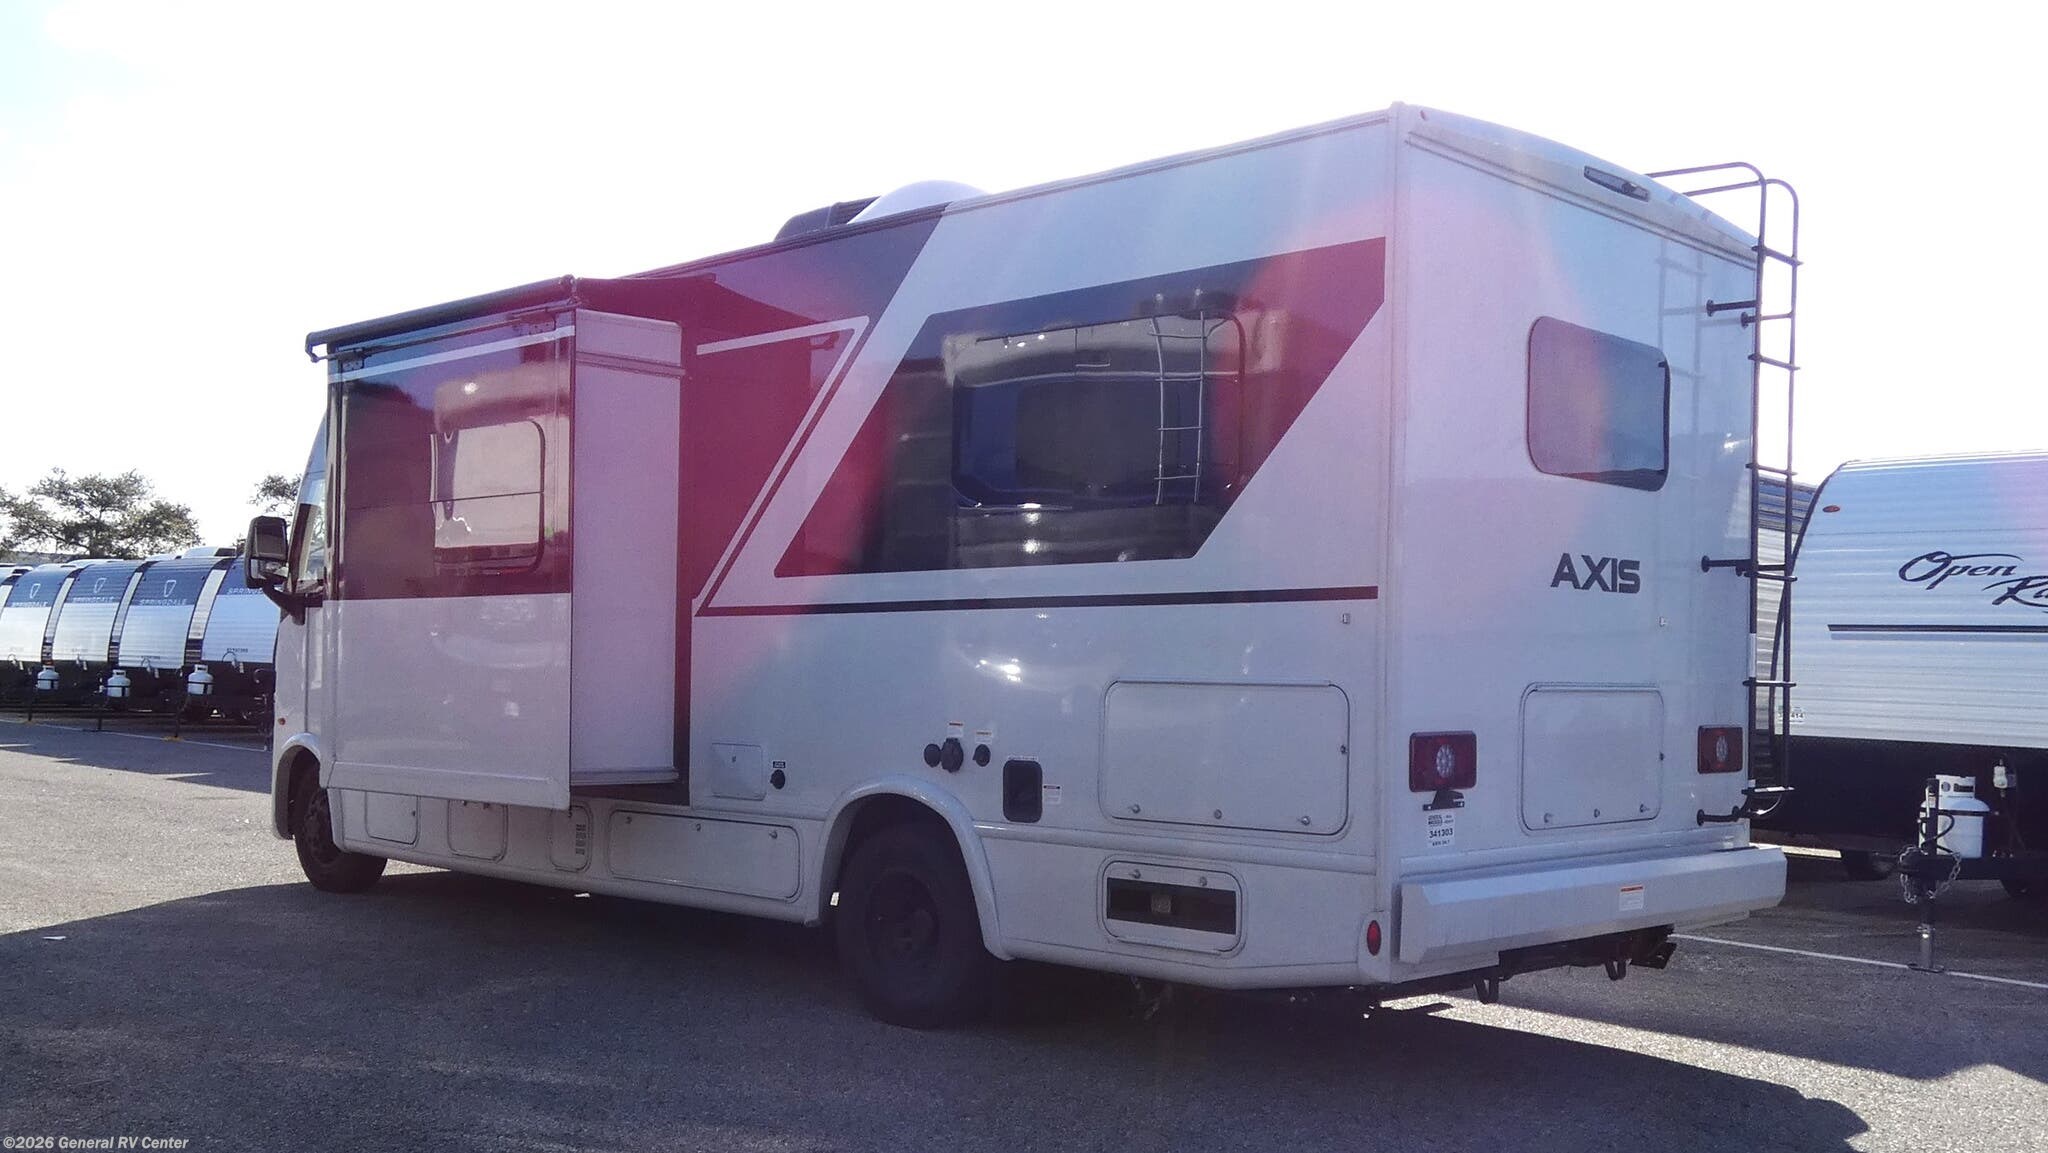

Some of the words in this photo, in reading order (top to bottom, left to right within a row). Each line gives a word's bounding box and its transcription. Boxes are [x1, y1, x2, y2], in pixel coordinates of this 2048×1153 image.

[1551, 552, 1641, 594] AXIS
[1899, 551, 2024, 590] Open
[139, 598, 188, 606] SPRINGDALE
